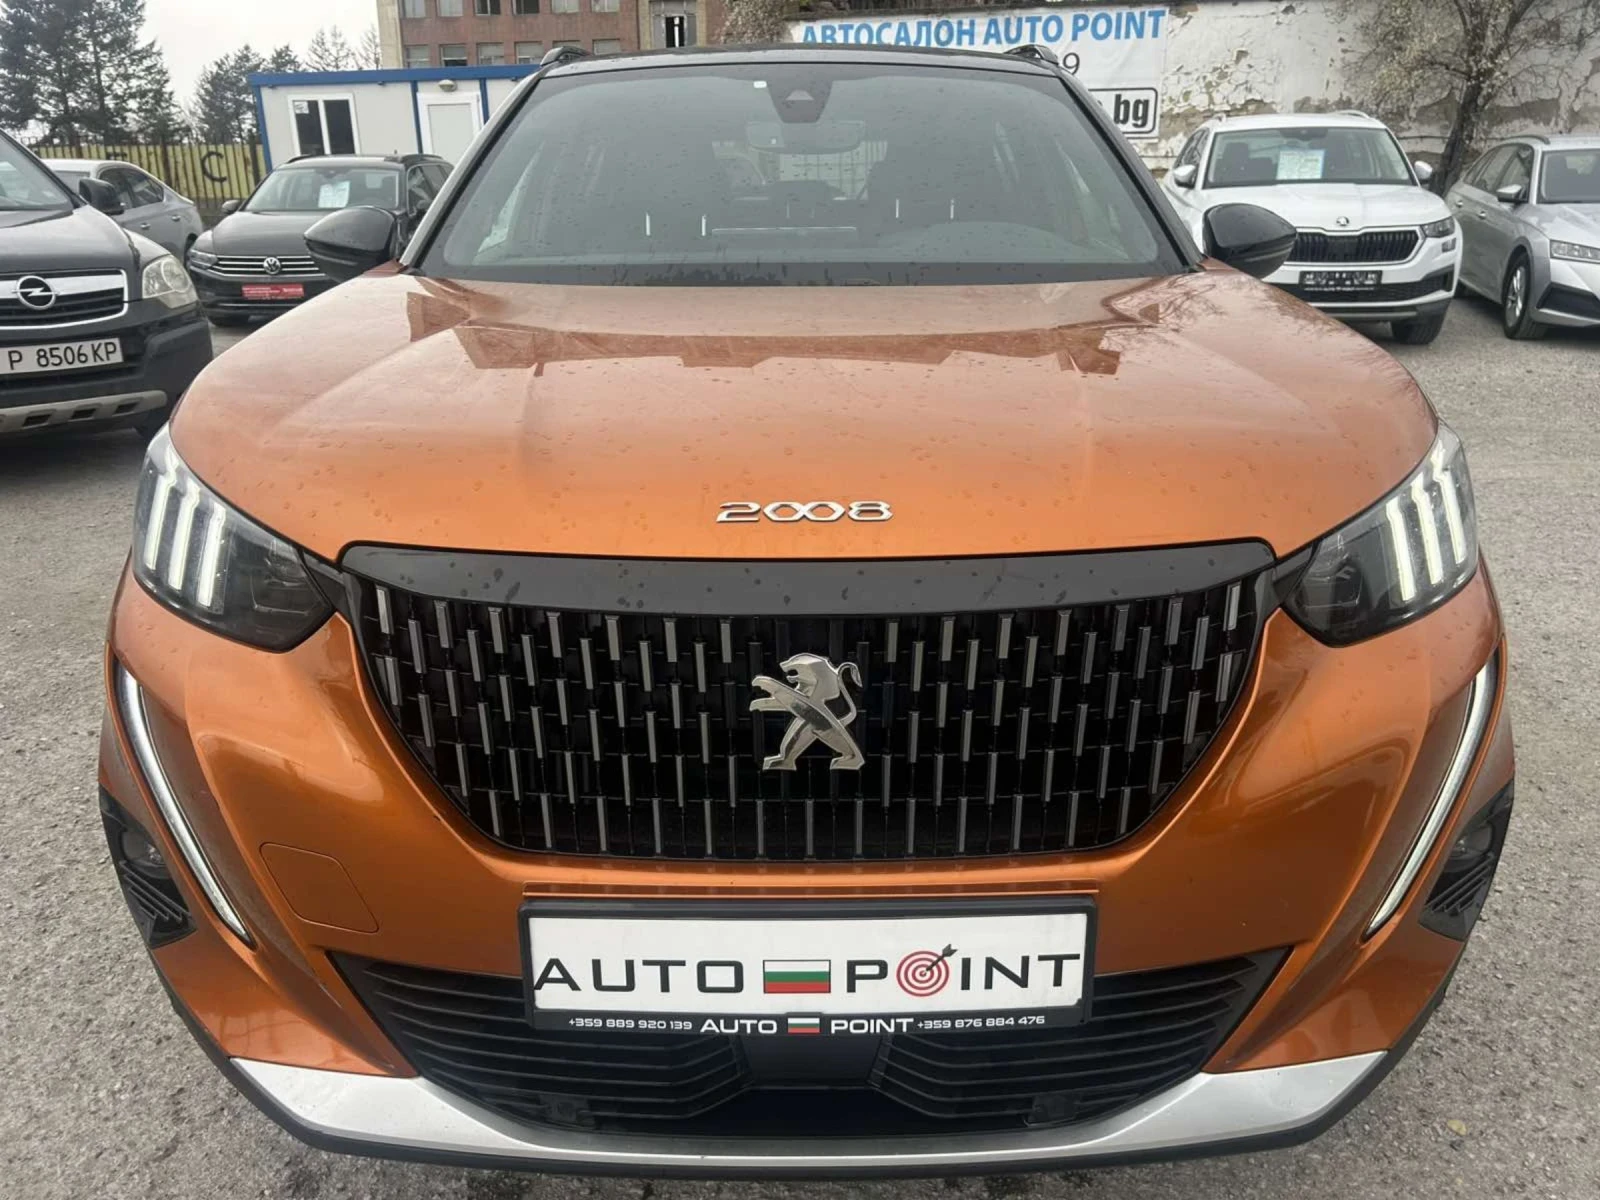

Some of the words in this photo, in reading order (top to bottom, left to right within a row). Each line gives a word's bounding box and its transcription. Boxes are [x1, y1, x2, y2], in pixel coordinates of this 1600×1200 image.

[802, 19, 976, 47] АВТОСАЛОН
[983, 14, 1063, 45] AUTO
[1071, 10, 1165, 41] POINT
[8, 350, 23, 370] P
[36, 345, 88, 368] 8506
[91, 342, 117, 362] KP
[716, 501, 893, 523] 2008
[533, 957, 744, 994] AUTO
[568, 1017, 603, 1028] +359
[606, 1018, 635, 1029] 889
[638, 1019, 667, 1030] 920
[670, 1020, 693, 1031] 139
[700, 1018, 778, 1034] AUTO
[831, 1018, 914, 1034] POINT
[917, 1018, 951, 1029] +359
[955, 1017, 983, 1028] 876
[986, 1016, 1015, 1027] 884
[1018, 1015, 1045, 1026] 476
